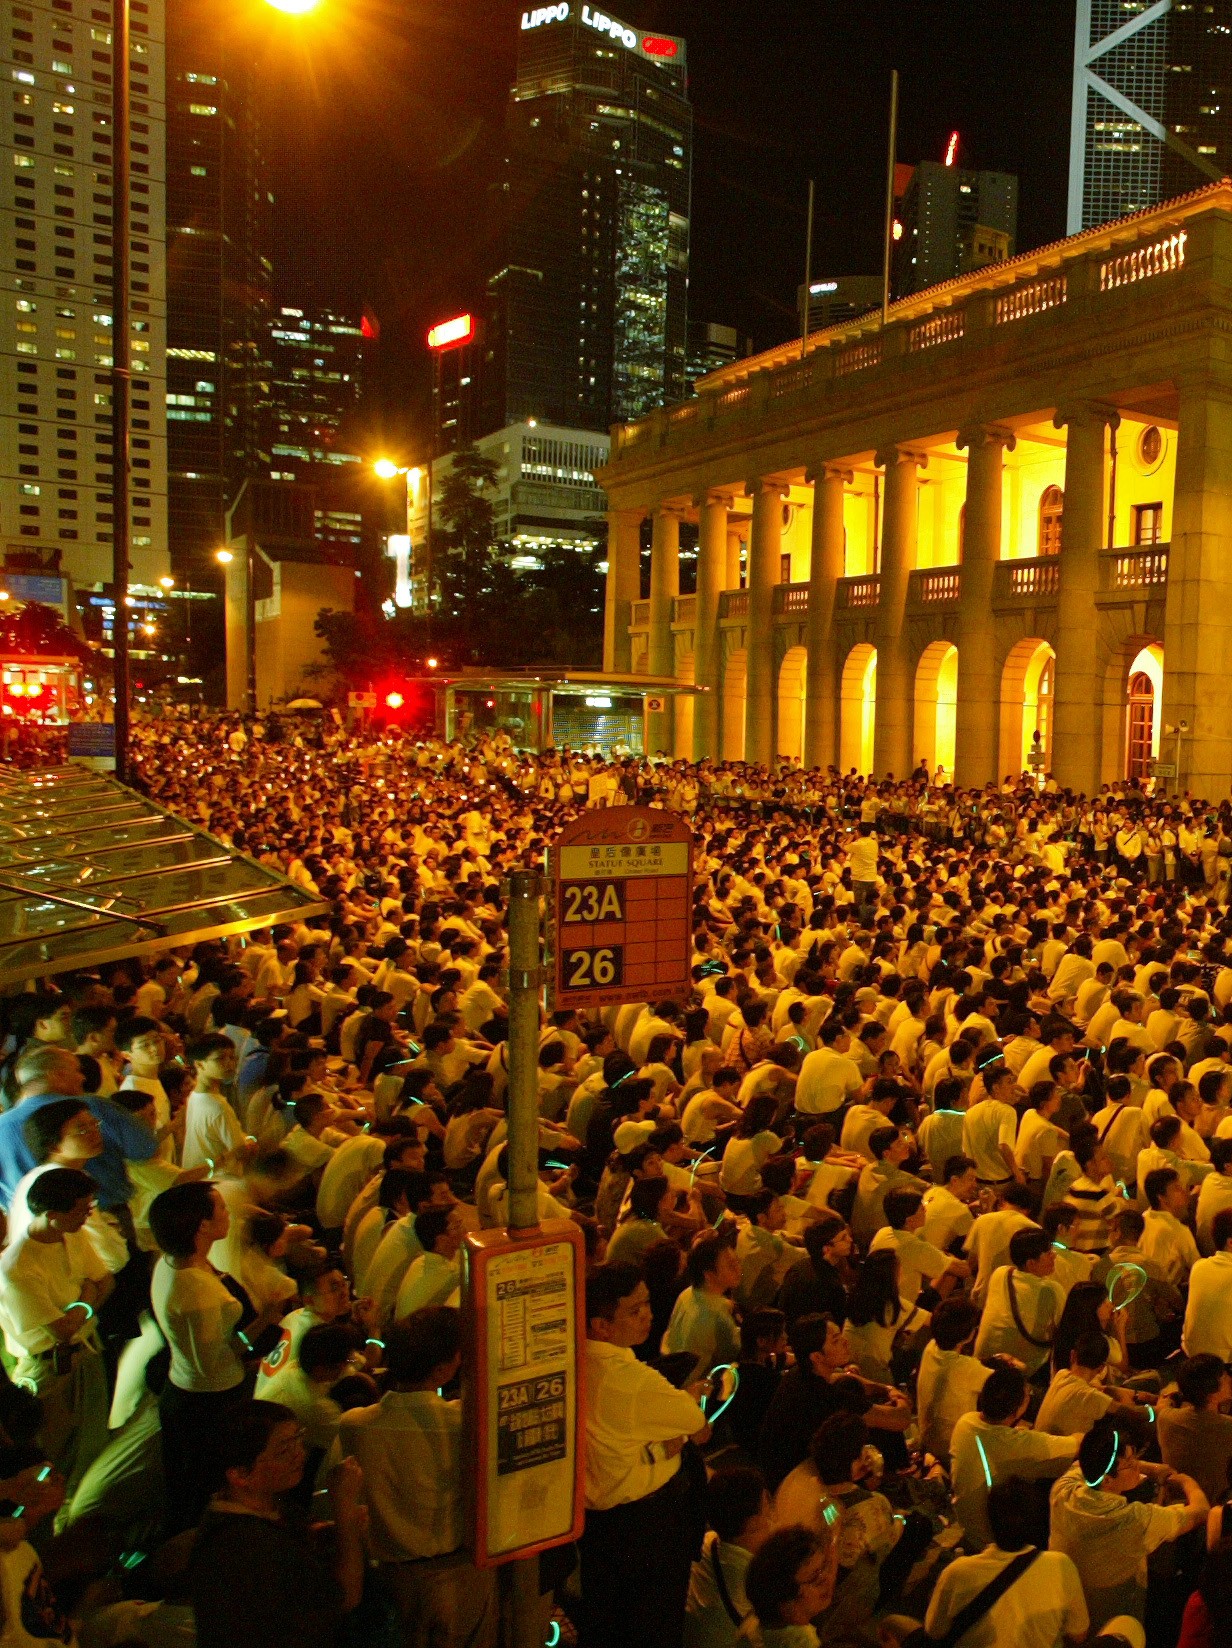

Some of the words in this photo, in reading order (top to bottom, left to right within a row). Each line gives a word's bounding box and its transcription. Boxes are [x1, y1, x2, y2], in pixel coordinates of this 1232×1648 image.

[521, 2, 569, 30] LIPPO
[581, 5, 637, 49] LIPPO
[588, 859, 623, 869] STATUE
[627, 858, 663, 868] SQUARE
[564, 885, 622, 922] 23A
[569, 949, 615, 986] 26
[498, 1281, 514, 1294] 26
[501, 1386, 528, 1409] 23A
[537, 1378, 563, 1399] 26
